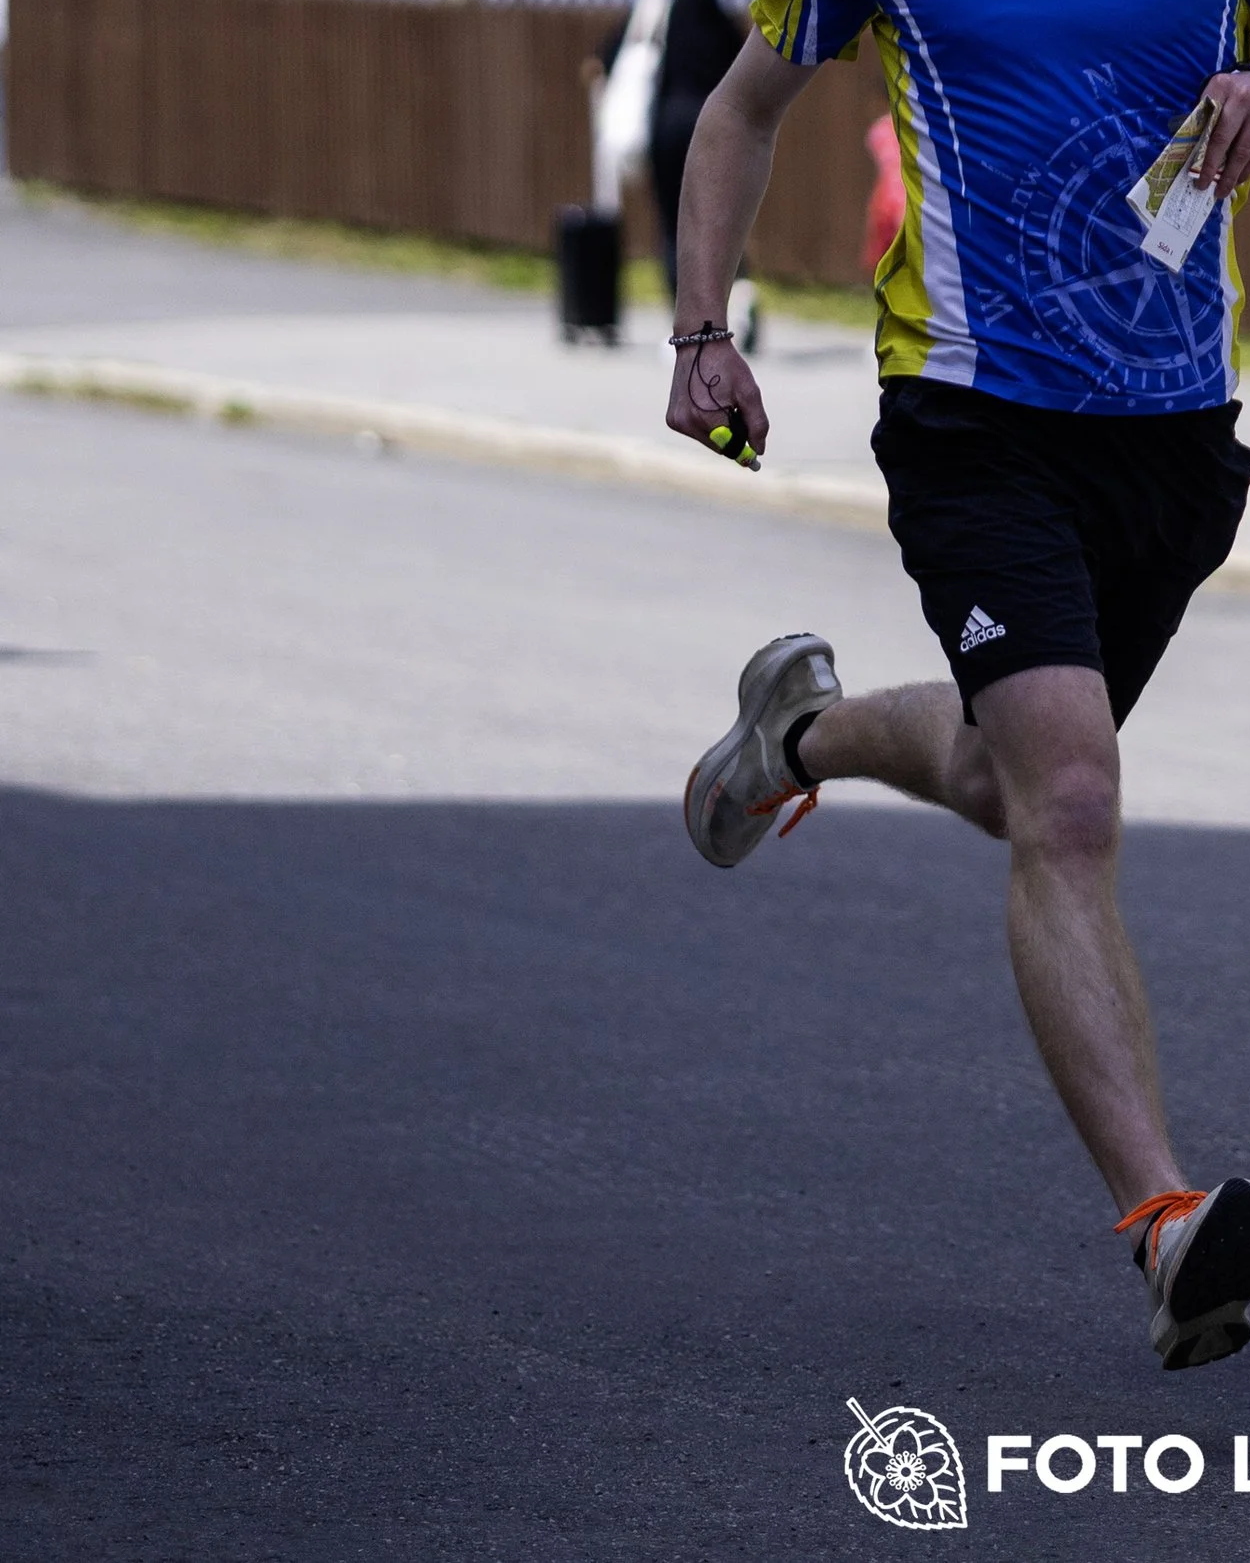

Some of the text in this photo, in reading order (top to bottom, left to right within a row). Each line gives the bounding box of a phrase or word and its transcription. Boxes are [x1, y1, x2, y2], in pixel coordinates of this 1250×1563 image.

[1083, 62, 1118, 100] N
[974, 285, 1014, 328] W
[960, 624, 1006, 652] adidas
